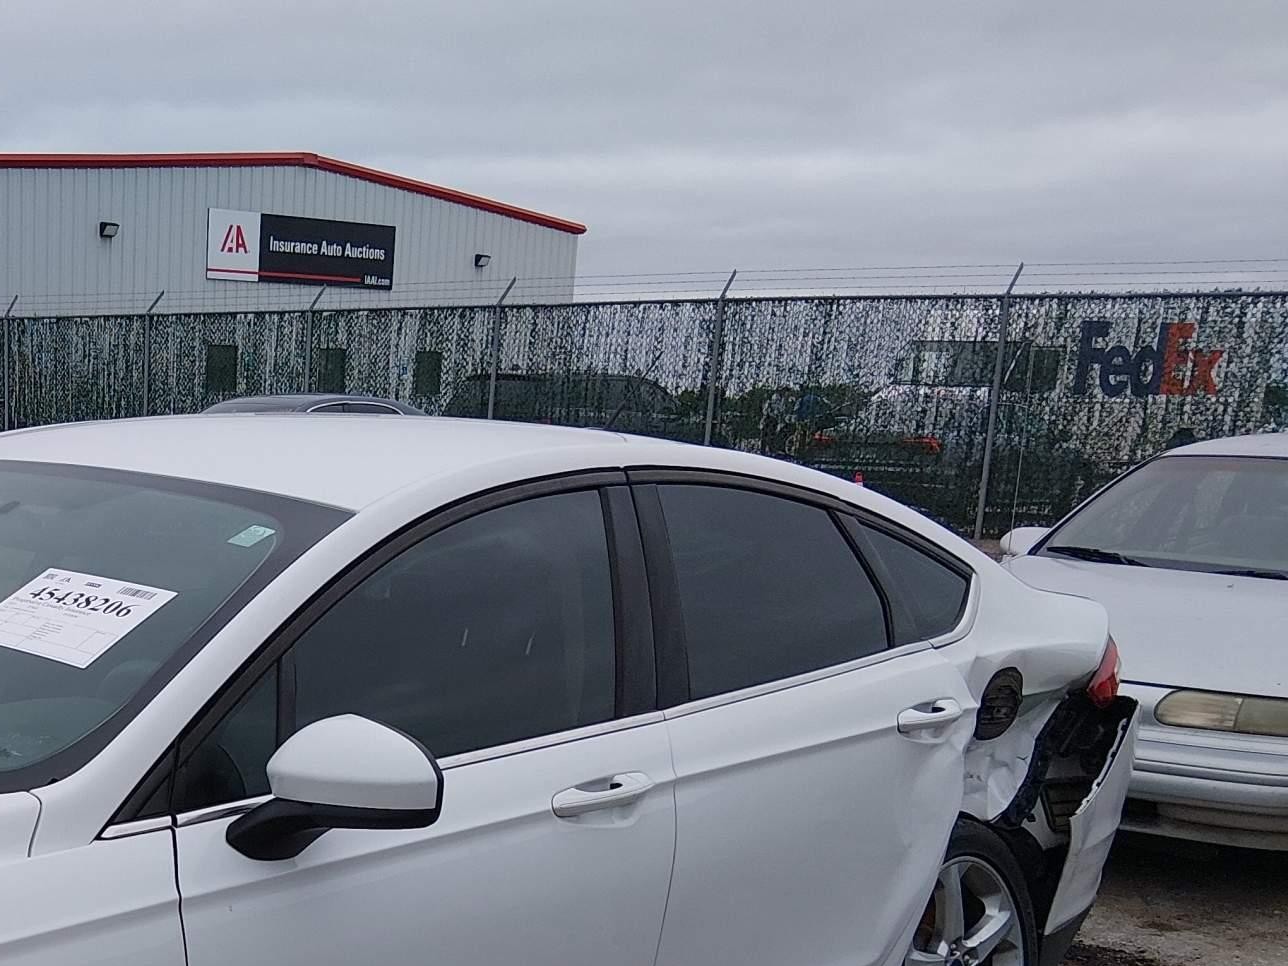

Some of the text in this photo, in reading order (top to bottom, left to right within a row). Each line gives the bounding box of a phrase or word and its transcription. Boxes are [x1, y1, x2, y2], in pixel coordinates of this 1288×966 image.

[269, 235, 385, 260] Insurance Auto Auctions
[1073, 320, 1226, 398] FedEx
[29, 586, 140, 617] 45438206
